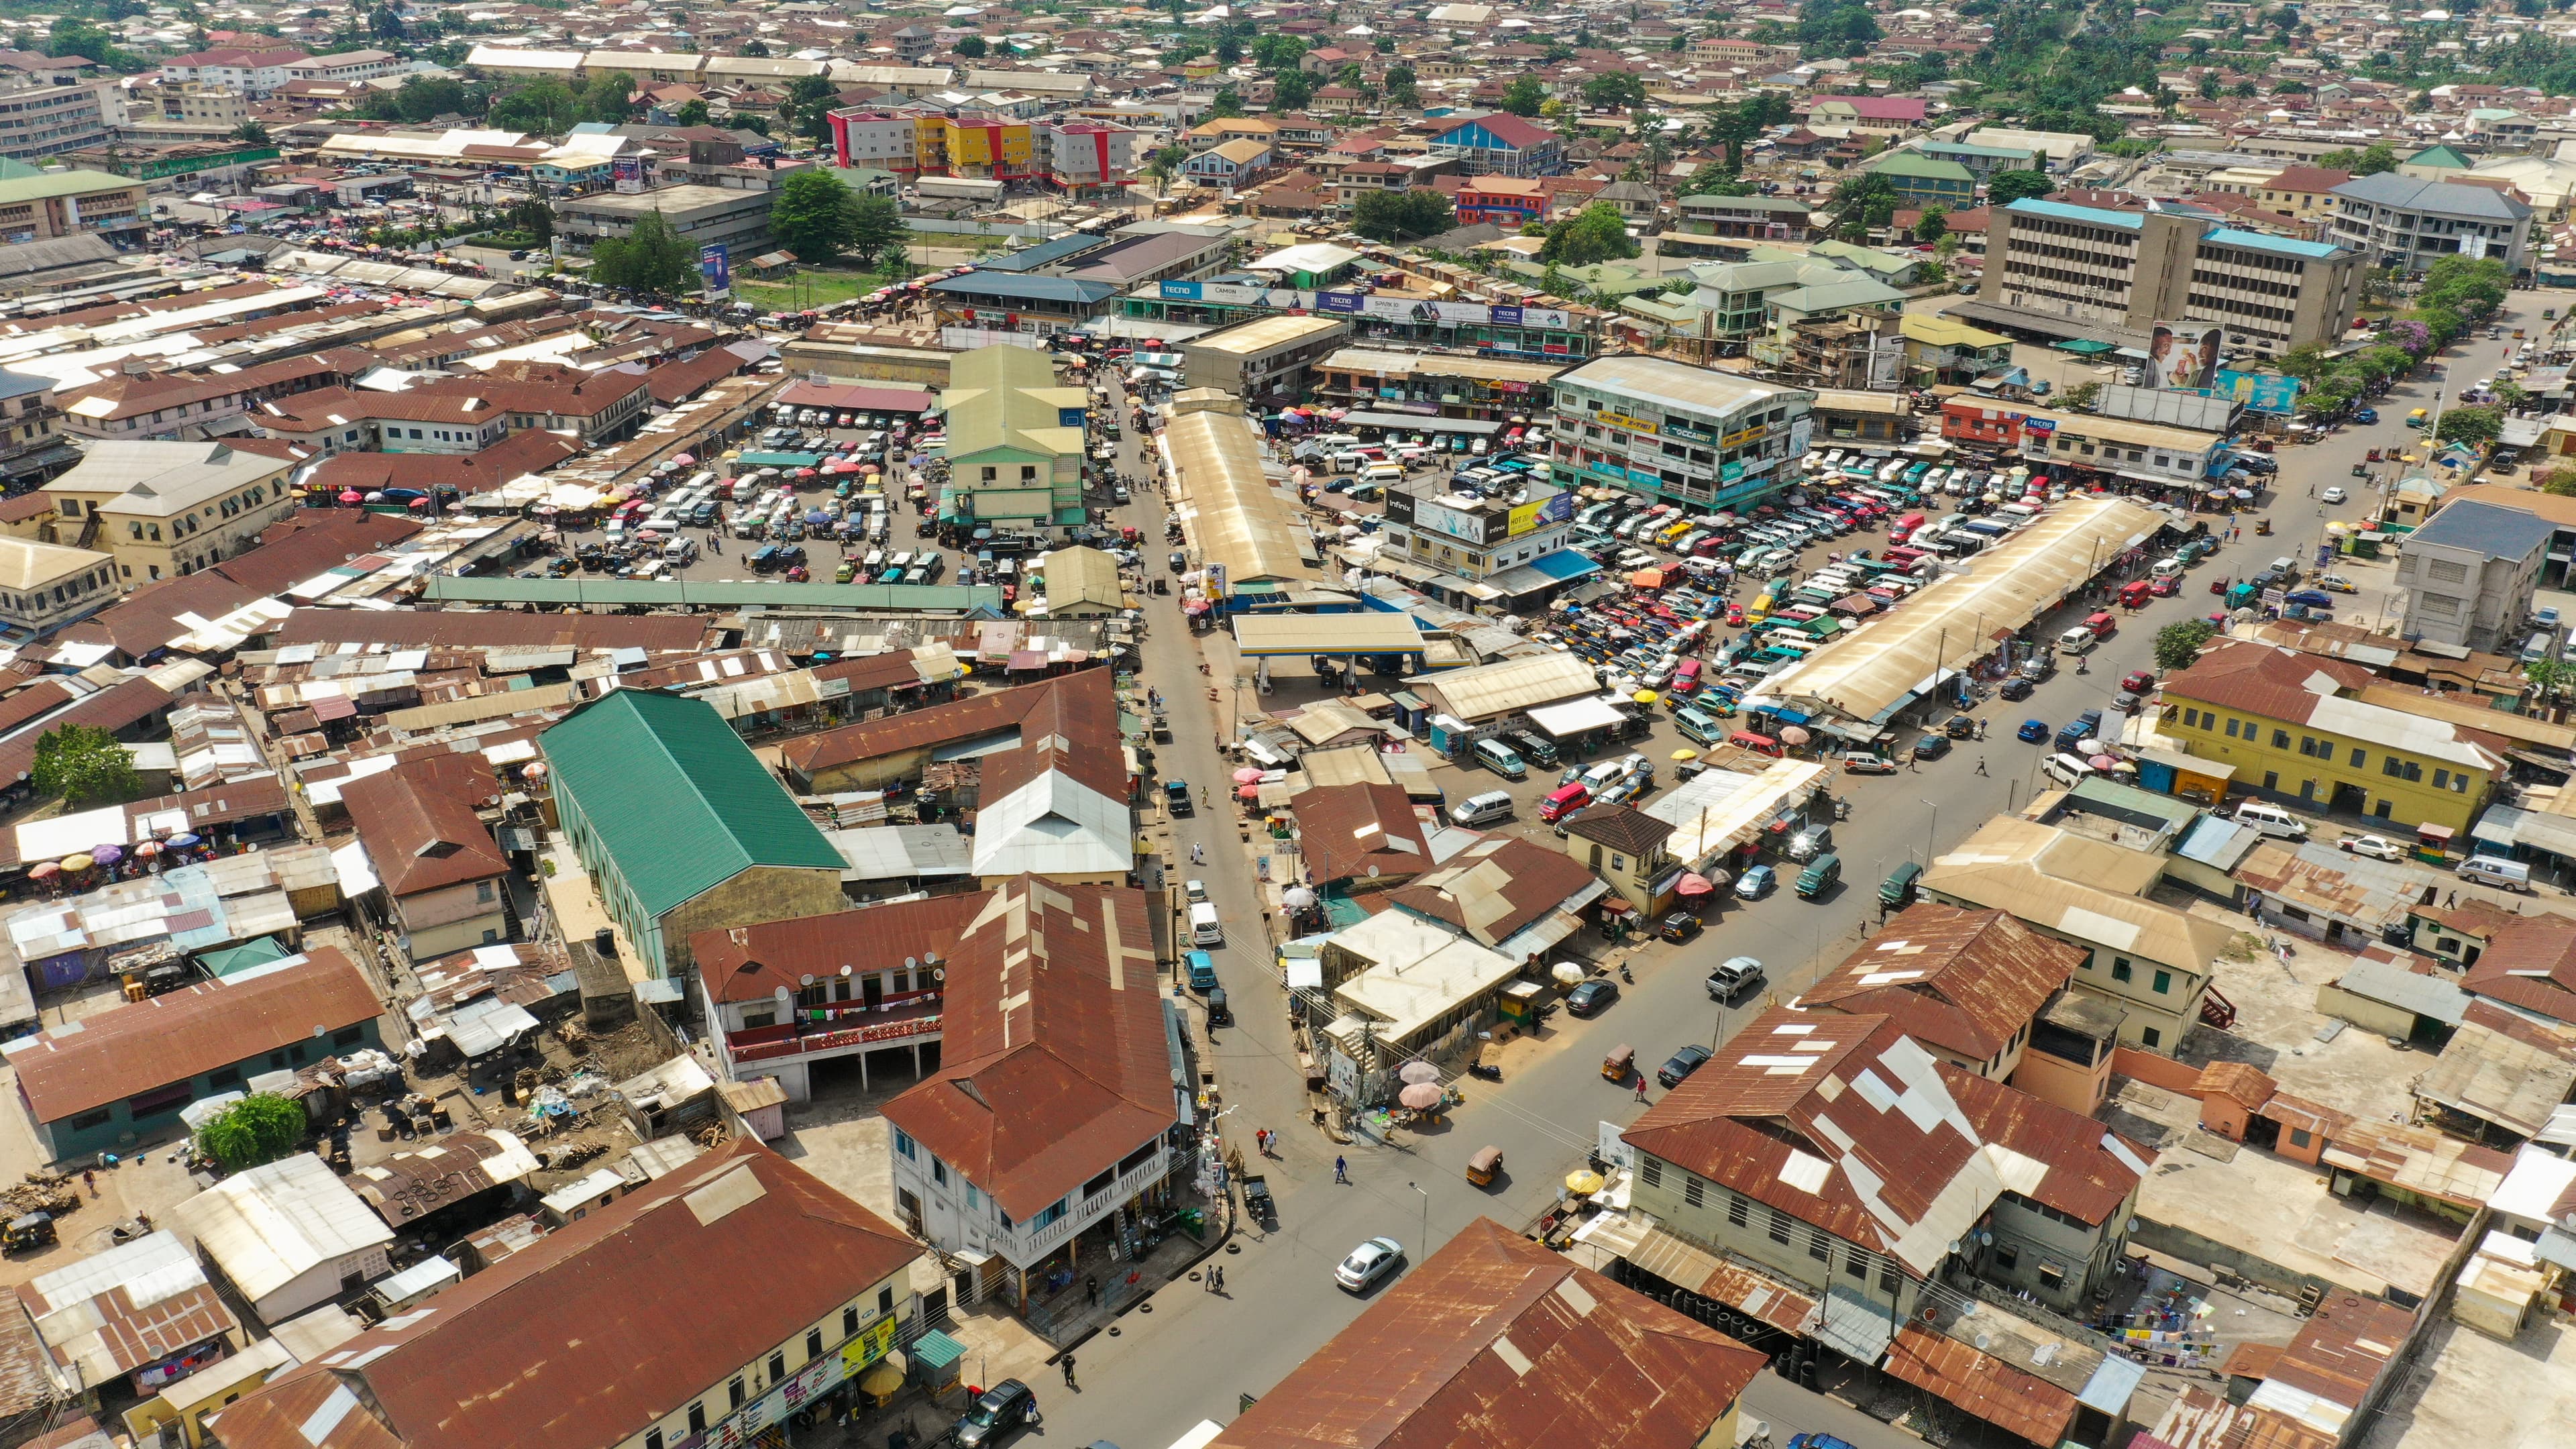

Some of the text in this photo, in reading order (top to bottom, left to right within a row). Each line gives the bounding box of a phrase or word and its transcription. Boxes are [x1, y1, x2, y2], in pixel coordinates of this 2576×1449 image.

[1164, 285, 1190, 294] TECNO
[1215, 286, 1237, 295] CAMON
[1330, 297, 1352, 305] TECNO
[2029, 419, 2053, 428] TECNO
[1389, 499, 1411, 513] Infinix
[1511, 516, 1521, 526] HOT
[1489, 524, 1506, 535] Infinix
